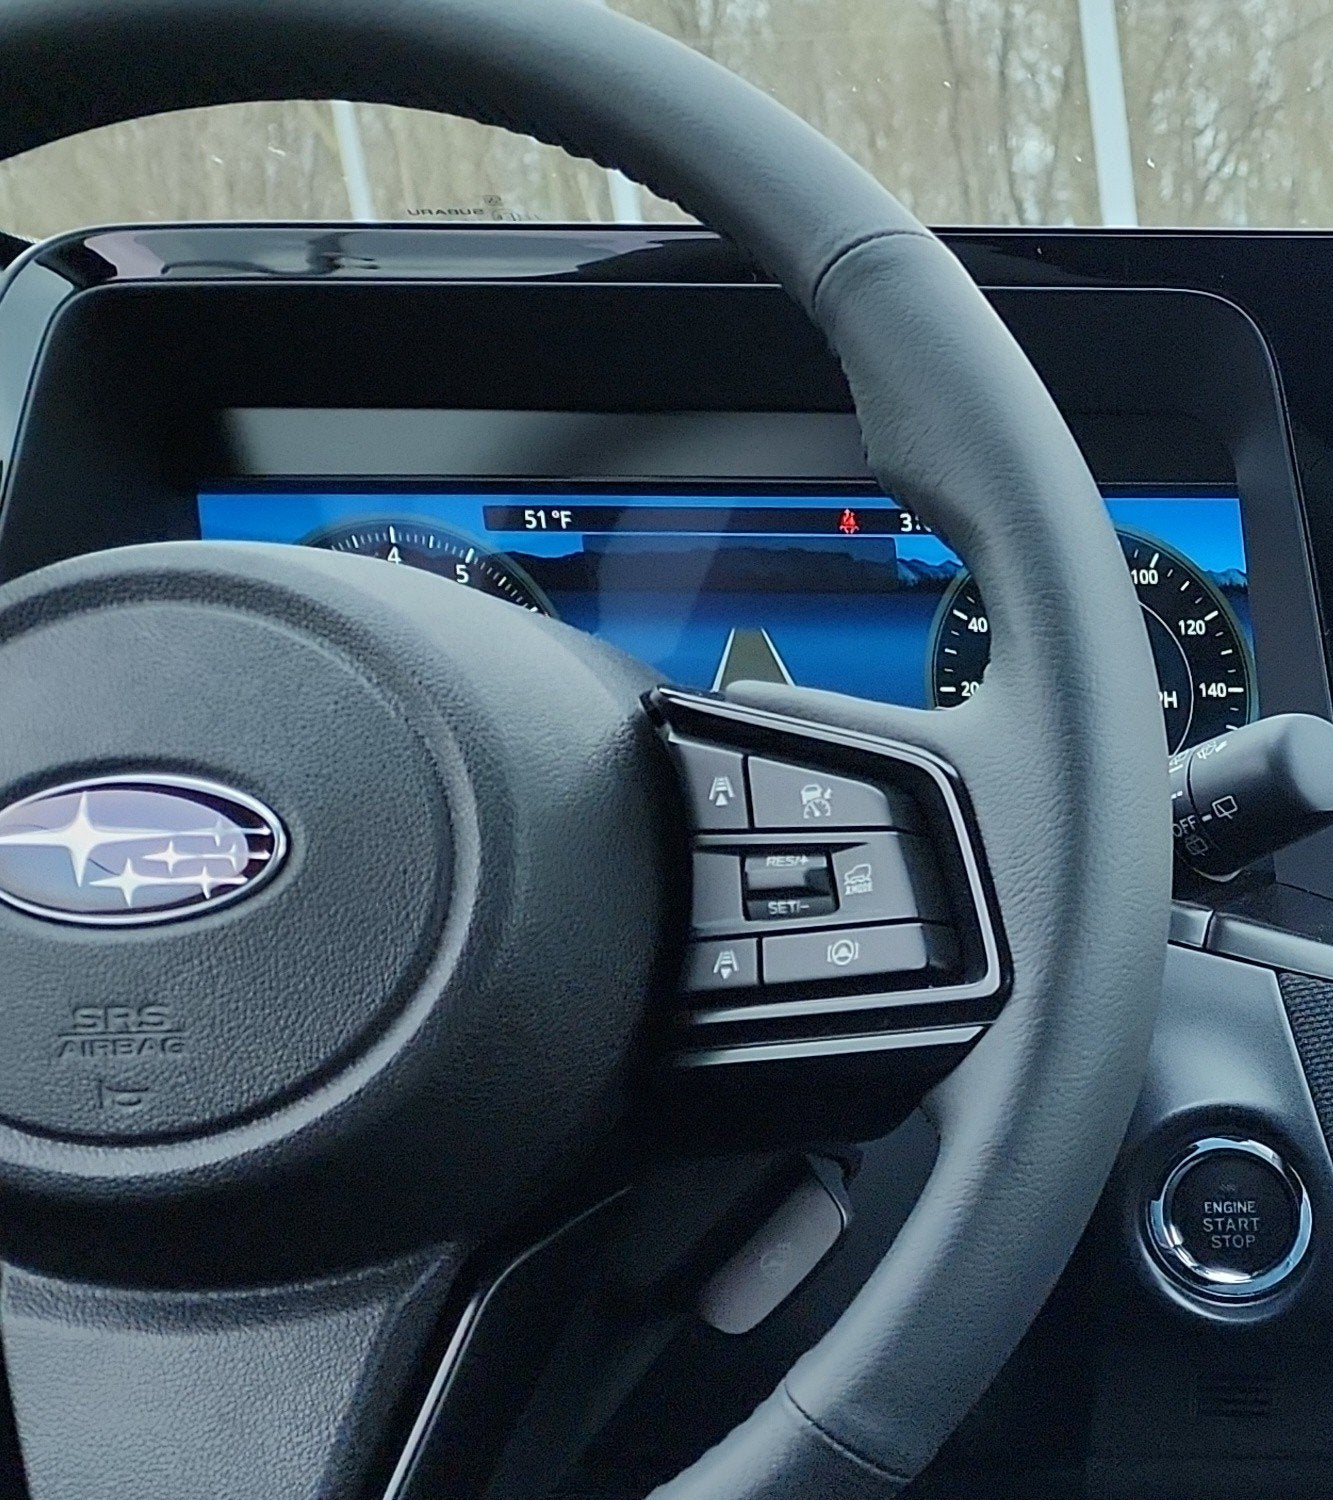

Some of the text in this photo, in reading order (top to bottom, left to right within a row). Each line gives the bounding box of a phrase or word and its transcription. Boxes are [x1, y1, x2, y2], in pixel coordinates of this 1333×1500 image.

[387, 546, 402, 565] 4
[455, 564, 469, 584] 5
[1130, 568, 1159, 585] 100
[967, 616, 988, 633] 40
[1178, 619, 1206, 636] 120
[1199, 682, 1227, 698] 140
[71, 1003, 172, 1030] SRS
[56, 1036, 187, 1058] AIRBAG
[1204, 1200, 1257, 1215] ENGINE
[1202, 1217, 1261, 1233] START
[1211, 1234, 1256, 1249] STOP
